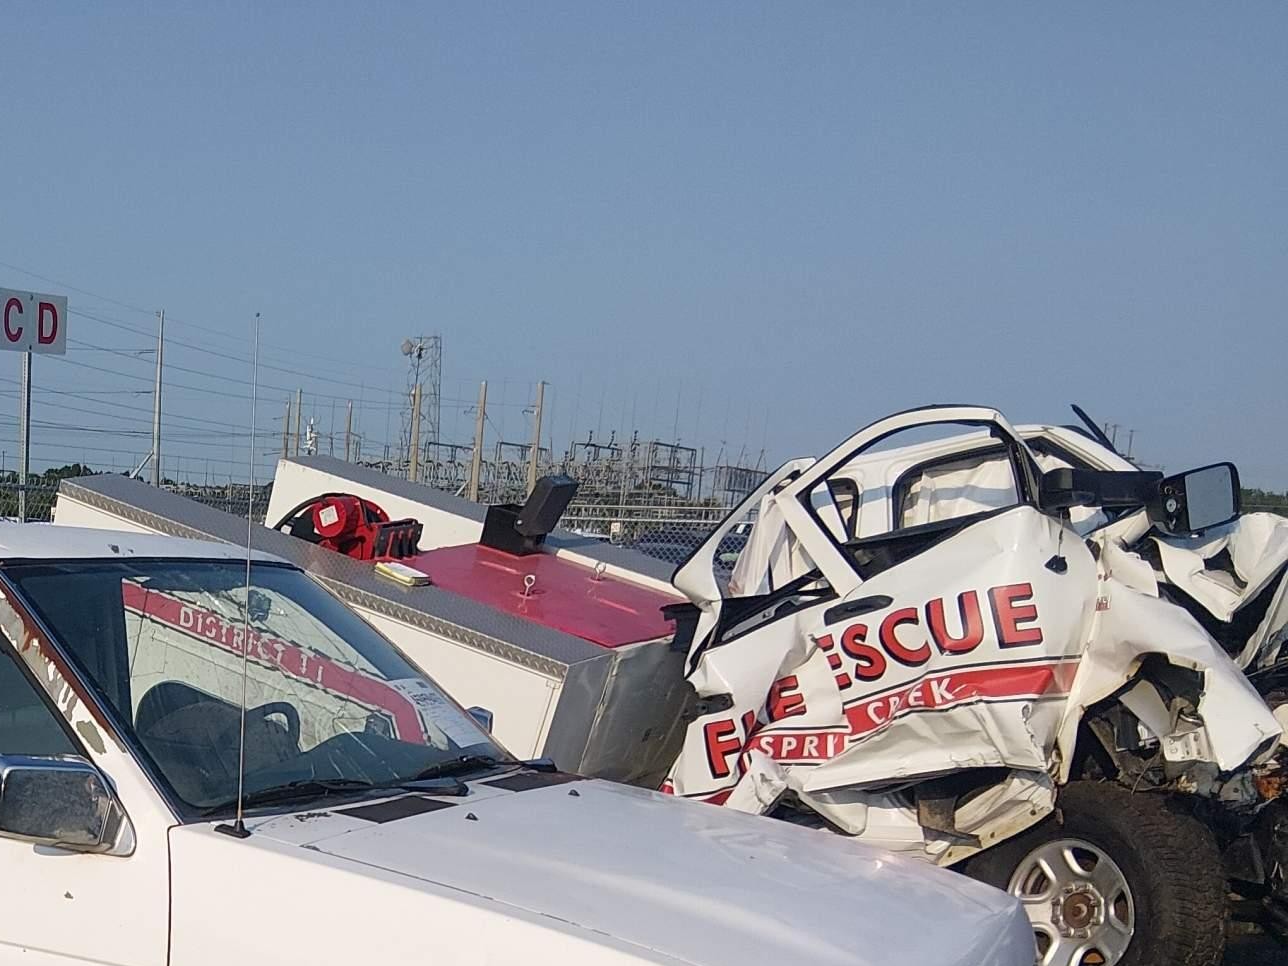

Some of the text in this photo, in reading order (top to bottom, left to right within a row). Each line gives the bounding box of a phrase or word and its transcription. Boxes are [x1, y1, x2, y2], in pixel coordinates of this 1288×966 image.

[4, 297, 58, 345] C D
[179, 605, 286, 666] DISTRICT
